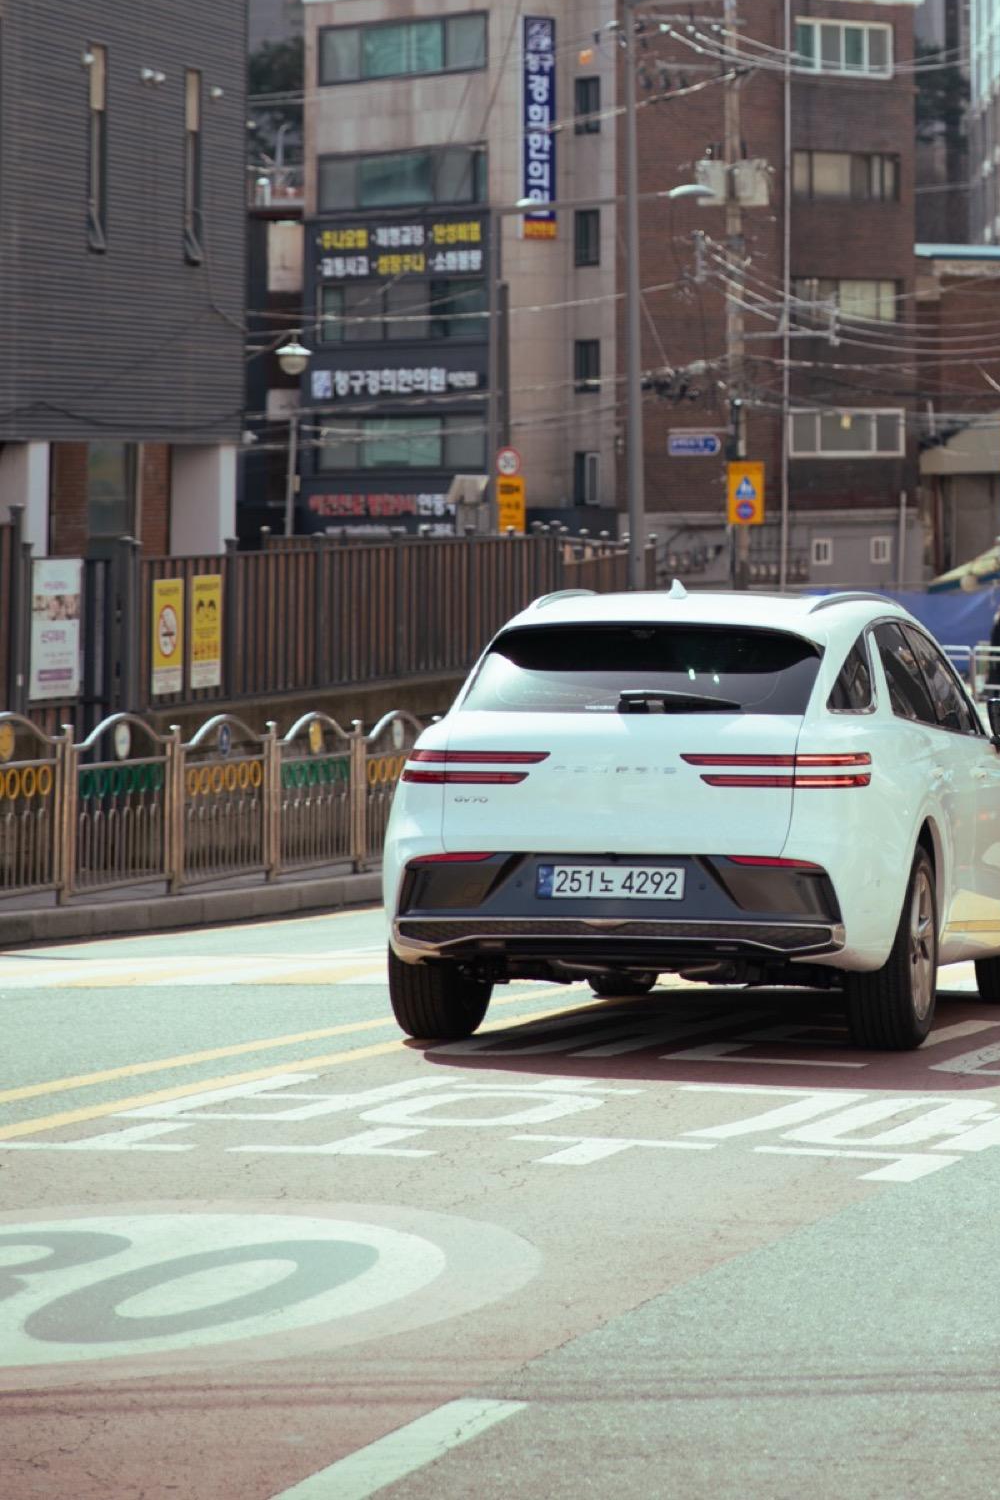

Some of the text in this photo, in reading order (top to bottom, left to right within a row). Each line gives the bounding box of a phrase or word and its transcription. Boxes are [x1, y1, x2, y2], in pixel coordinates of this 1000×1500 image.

[454, 795, 488, 804] GV70
[555, 869, 678, 895] 251노 4292
